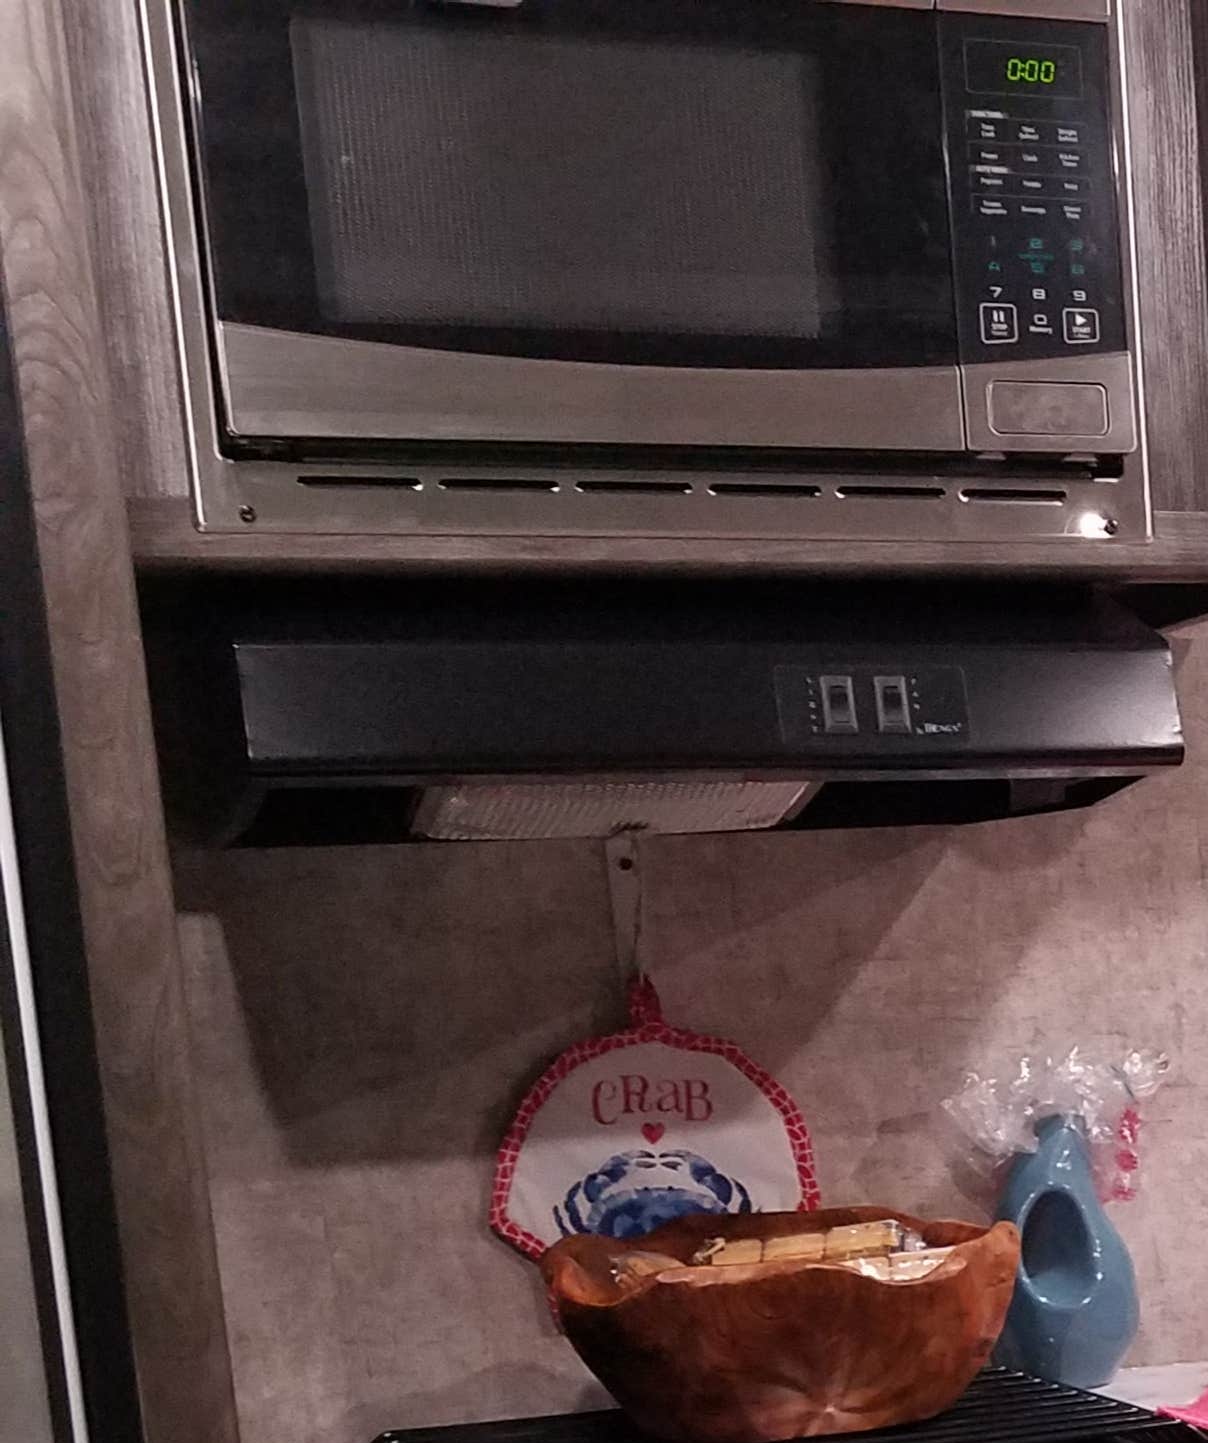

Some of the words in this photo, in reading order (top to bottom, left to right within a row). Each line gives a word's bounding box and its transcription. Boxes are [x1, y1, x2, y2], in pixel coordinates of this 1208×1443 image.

[1007, 58, 1055, 83] 0:00
[989, 286, 1002, 298] 7
[1032, 288, 1046, 300] 8
[1072, 290, 1086, 301] 9
